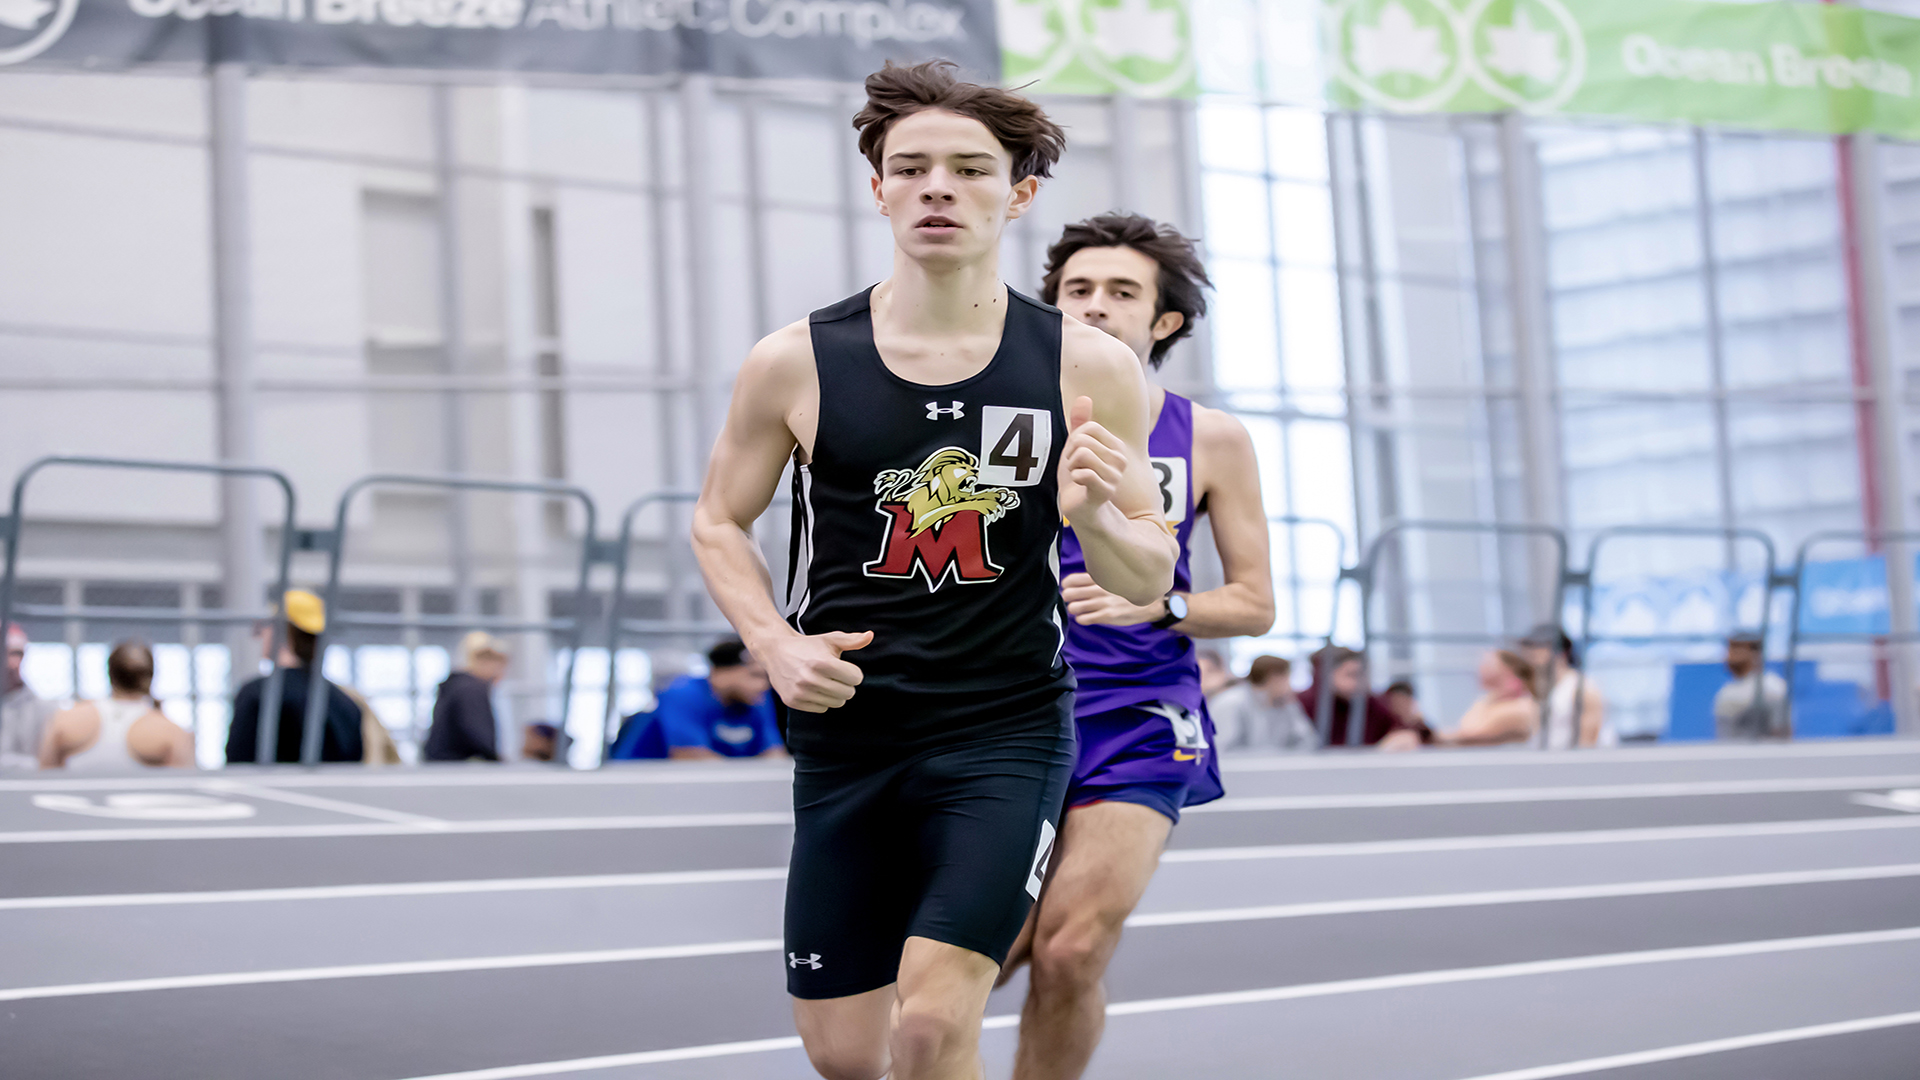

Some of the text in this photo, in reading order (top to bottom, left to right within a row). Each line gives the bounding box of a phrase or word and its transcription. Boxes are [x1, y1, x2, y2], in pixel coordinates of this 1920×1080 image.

[524, 0, 730, 33] Athletc
[728, 0, 967, 50] Complex
[1621, 33, 1767, 86] Ocean
[988, 413, 1038, 481] 4
[864, 502, 1003, 590] M
